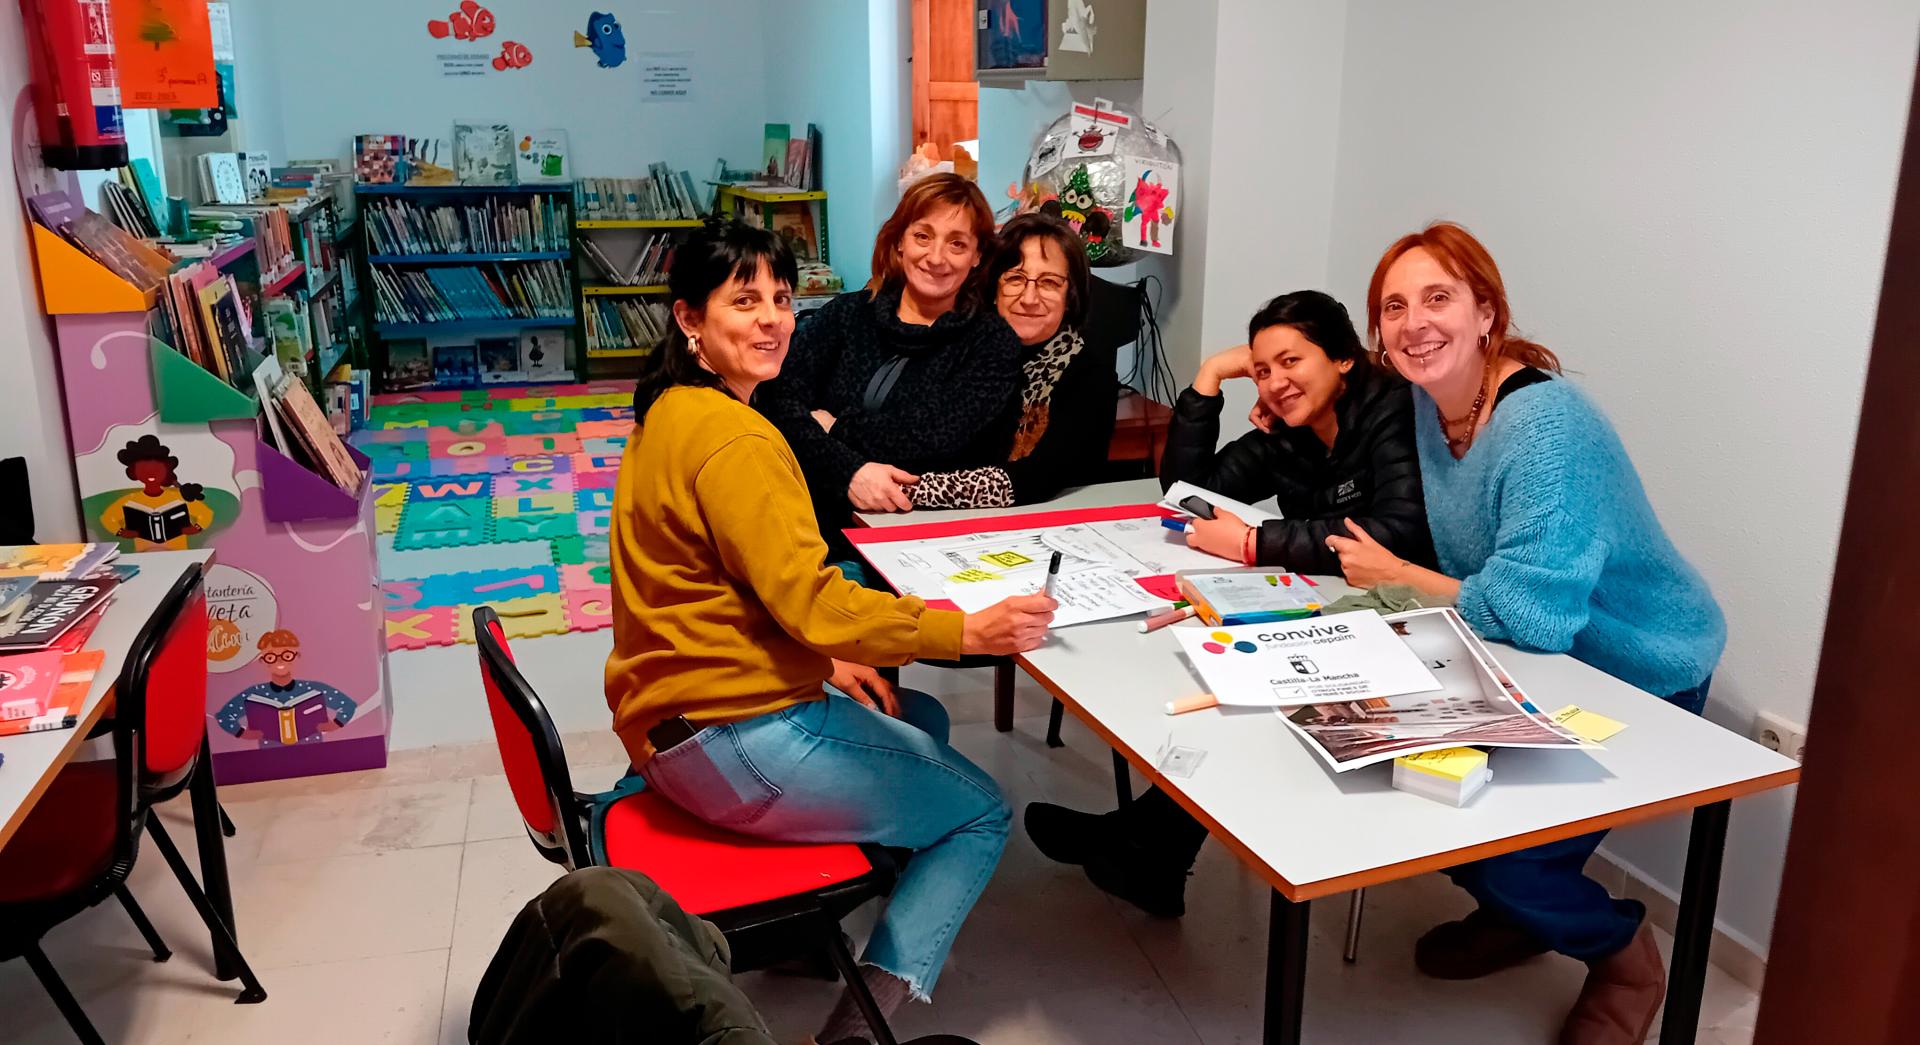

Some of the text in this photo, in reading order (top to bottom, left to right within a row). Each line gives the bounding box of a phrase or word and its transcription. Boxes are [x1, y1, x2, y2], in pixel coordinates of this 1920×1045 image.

[206, 584, 255, 599] tantería
[20, 585, 100, 634] GRUÑÓN
[207, 602, 252, 624] leta
[1257, 624, 1350, 642] convive
[1313, 634, 1356, 645] cepaim
[1322, 672, 1360, 681] Mancha
